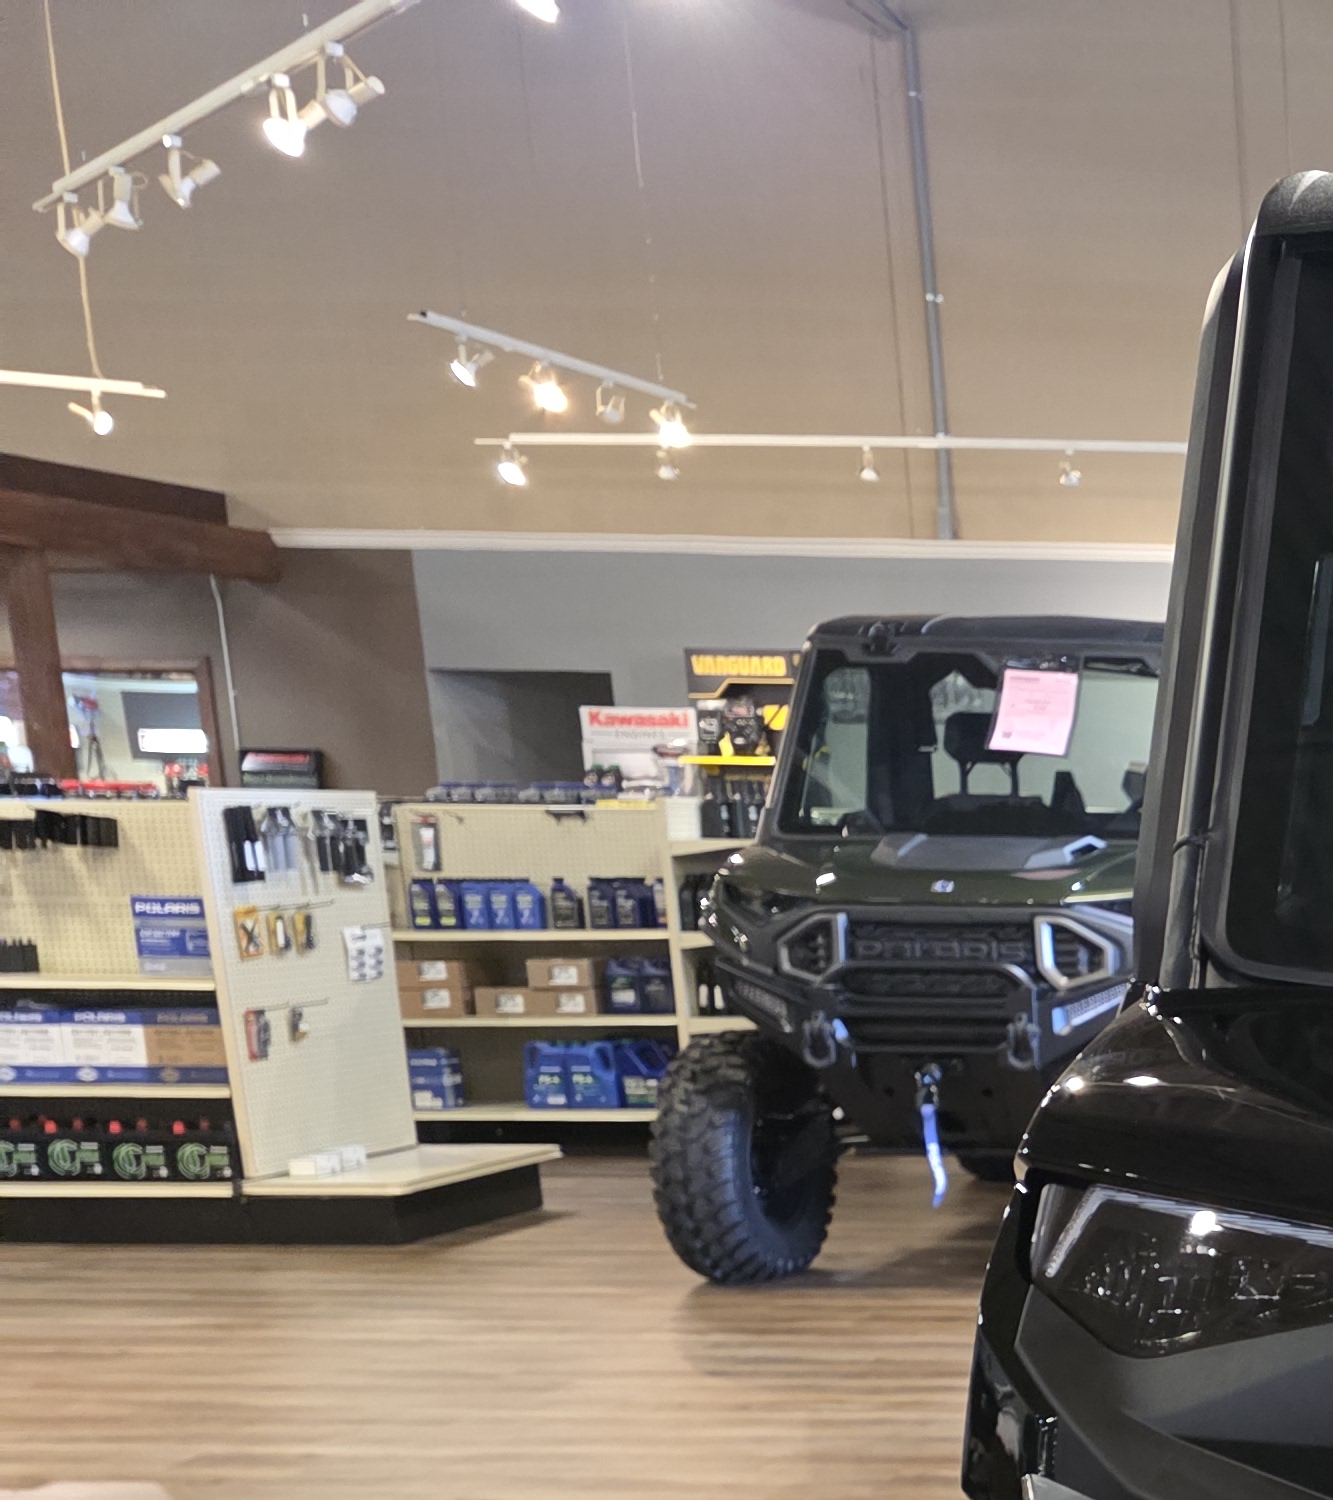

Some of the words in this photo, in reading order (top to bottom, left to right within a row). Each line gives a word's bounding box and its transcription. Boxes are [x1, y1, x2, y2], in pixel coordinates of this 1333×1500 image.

[691, 655, 787, 676] VANGUARD
[588, 709, 689, 729] Kawasaki
[134, 901, 201, 914] POLARIS
